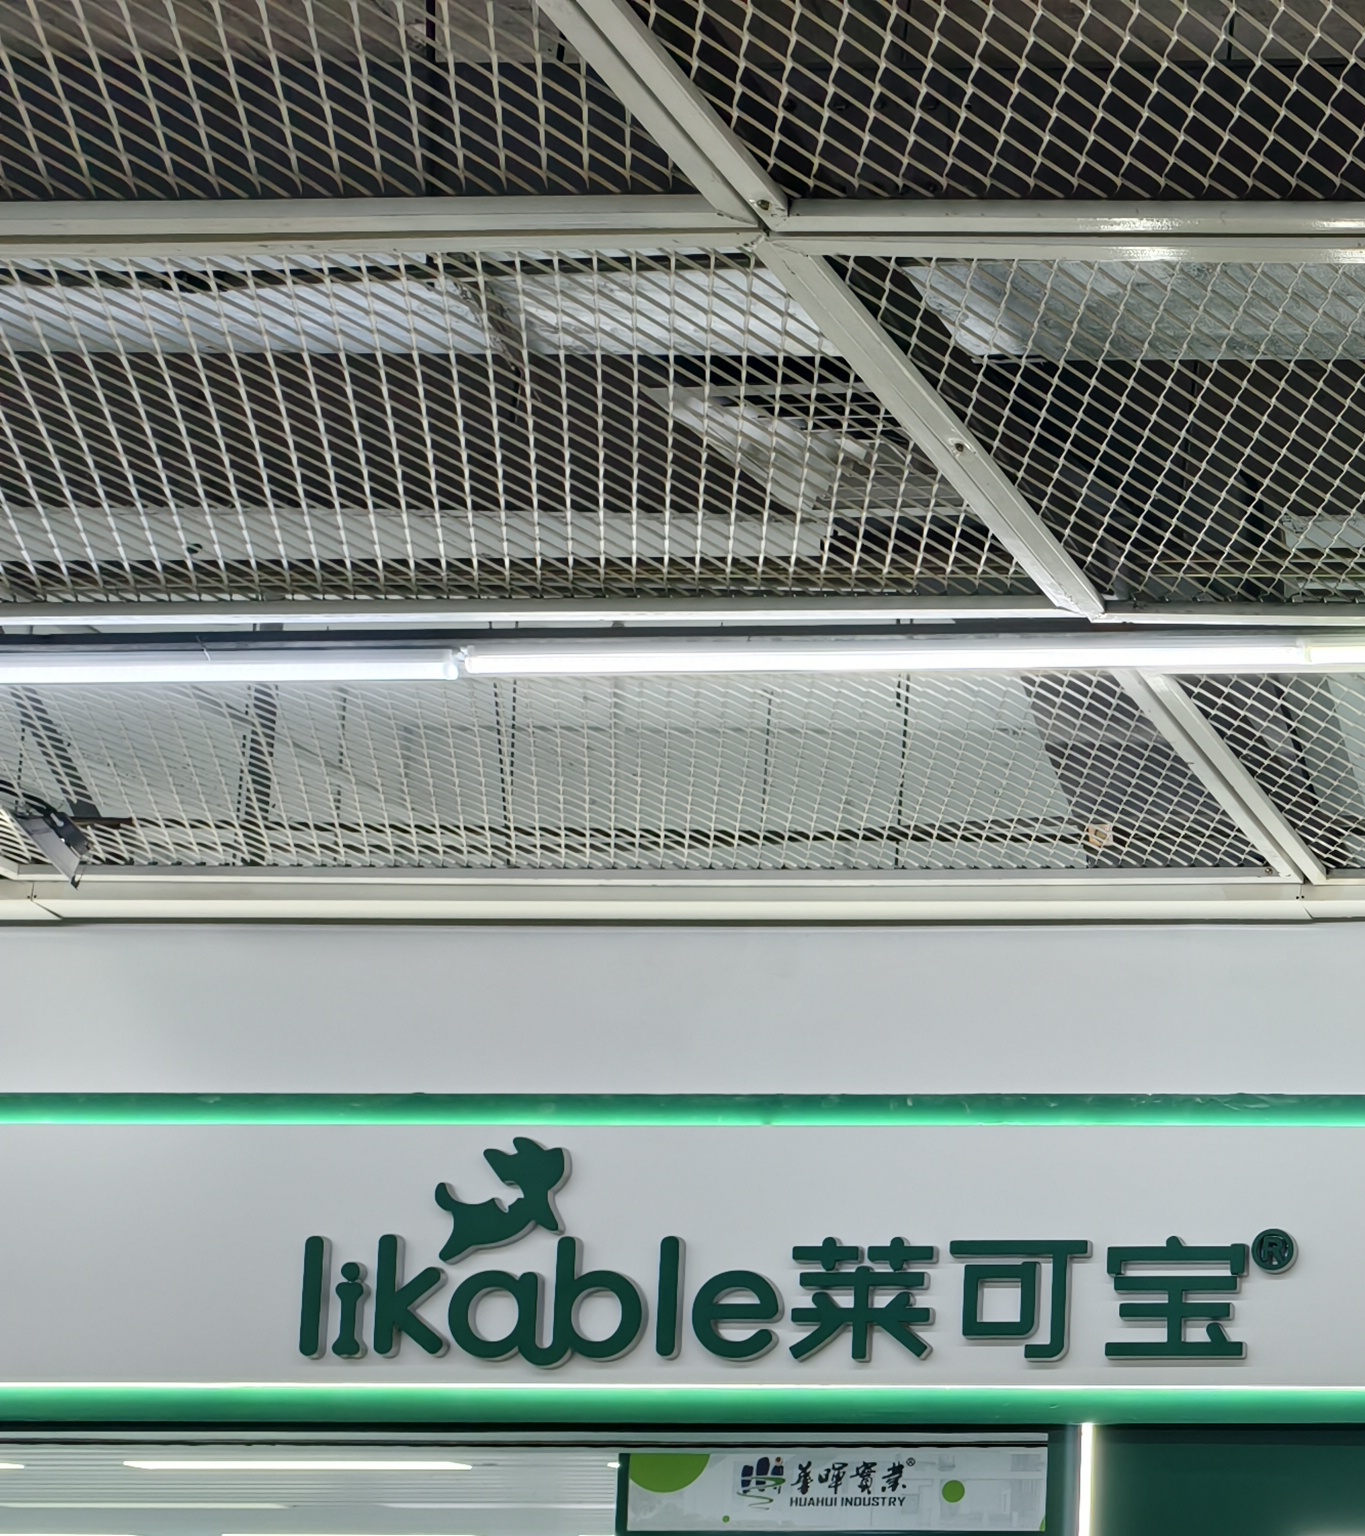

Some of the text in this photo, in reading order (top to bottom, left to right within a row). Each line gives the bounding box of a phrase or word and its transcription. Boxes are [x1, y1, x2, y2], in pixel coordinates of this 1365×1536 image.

[298, 1234, 784, 1368] likable
[789, 1497, 906, 1508] HUAHUI INDUSTRY
